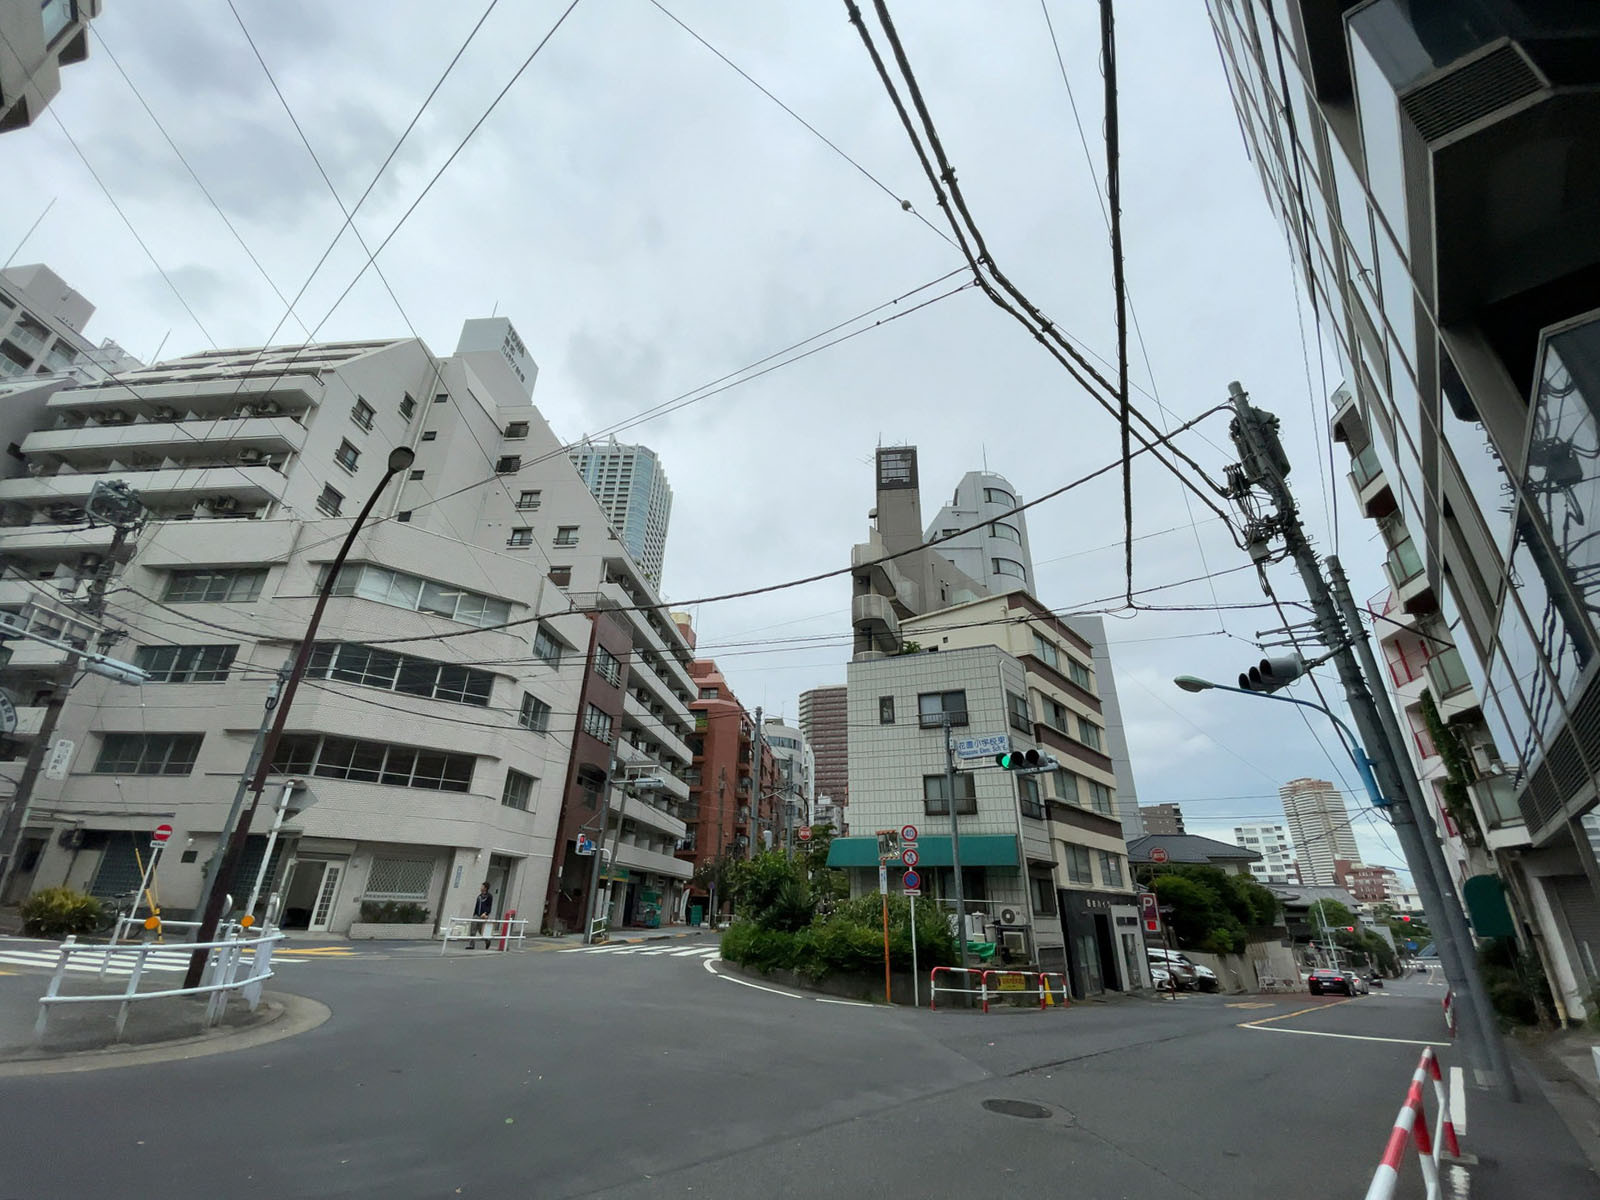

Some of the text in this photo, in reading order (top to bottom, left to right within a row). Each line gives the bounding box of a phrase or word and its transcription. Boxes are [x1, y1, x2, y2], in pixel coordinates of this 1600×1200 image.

[508, 325, 524, 357] TOWA
[959, 736, 1005, 749] 花園小学校東
[1143, 897, 1153, 911] P
